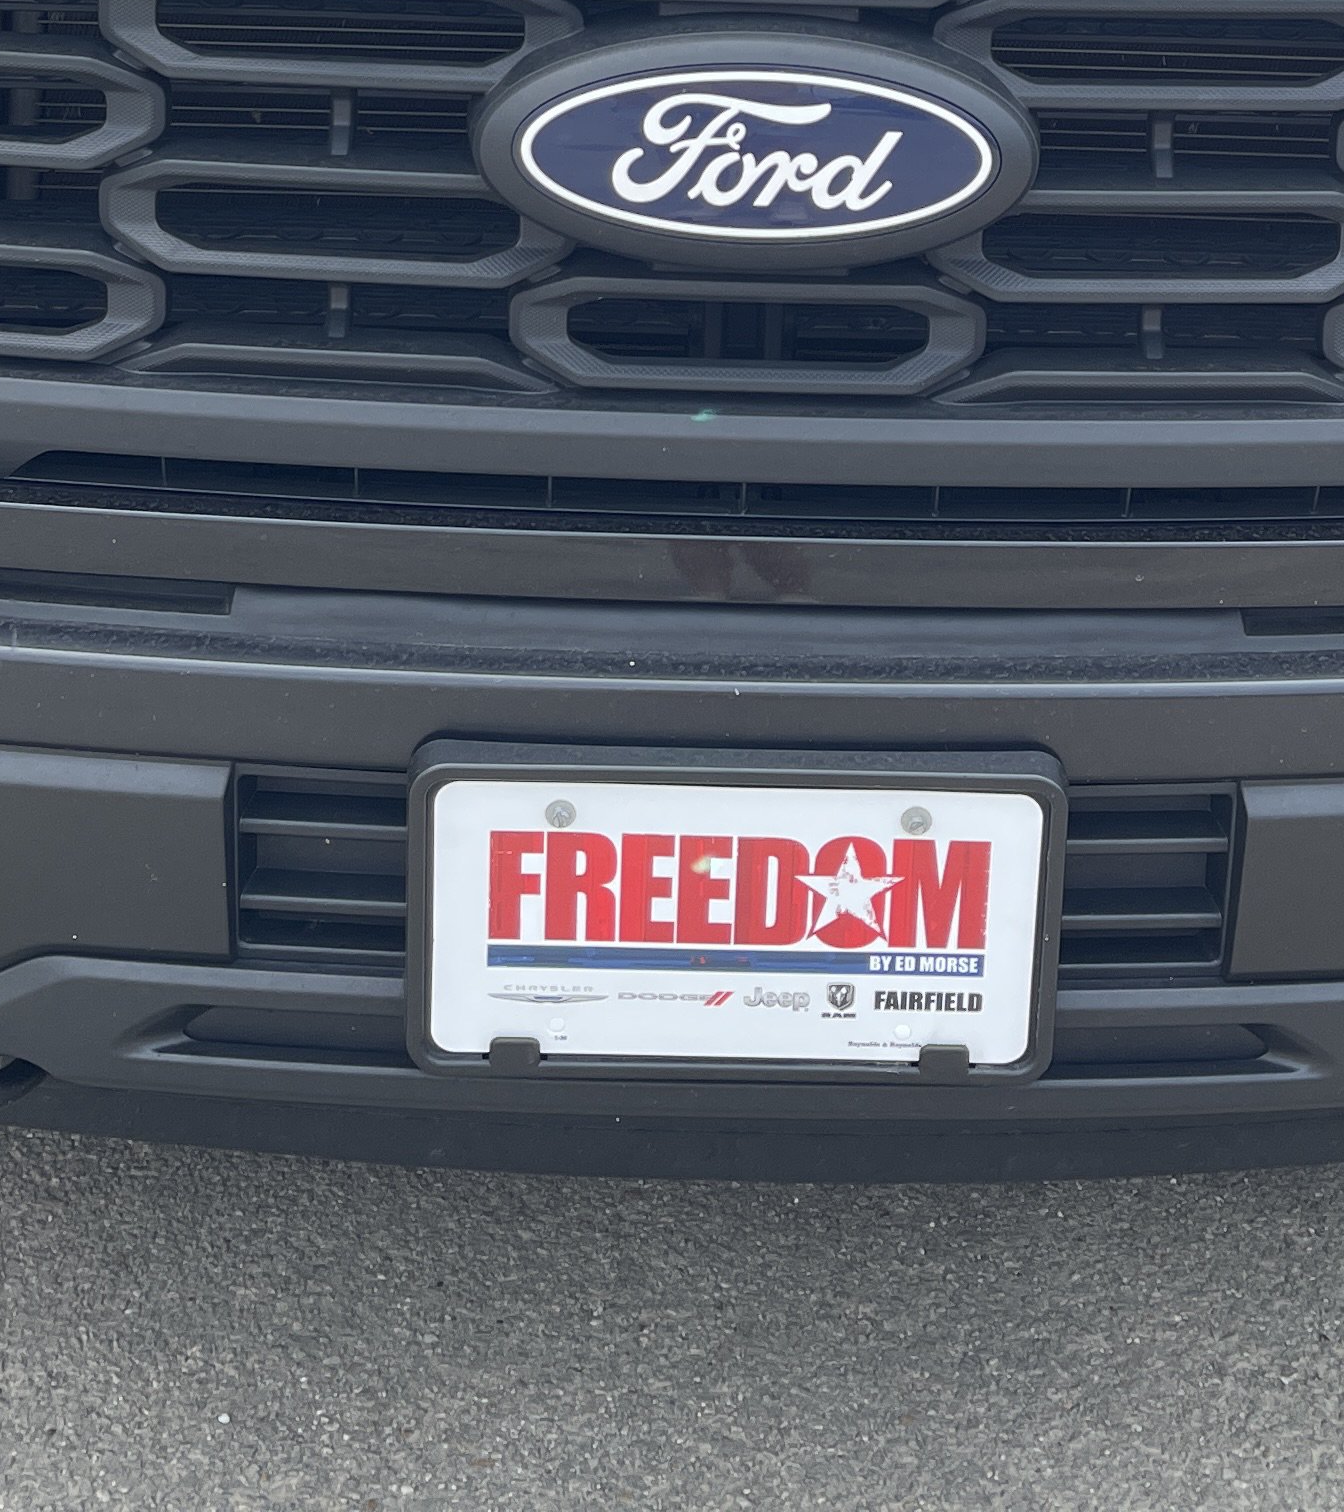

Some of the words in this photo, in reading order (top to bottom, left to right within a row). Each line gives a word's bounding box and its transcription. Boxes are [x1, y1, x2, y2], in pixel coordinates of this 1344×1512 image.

[611, 93, 904, 210] Ford
[488, 830, 992, 950] FREEDOM
[869, 955, 890, 972] BY
[895, 956, 916, 972] ED
[919, 956, 979, 974] MORSE
[503, 984, 594, 993] CHRYSLER
[617, 991, 711, 1002] DODGE
[743, 987, 810, 1012] Jeep
[874, 990, 984, 1013] FAIRFIELD
